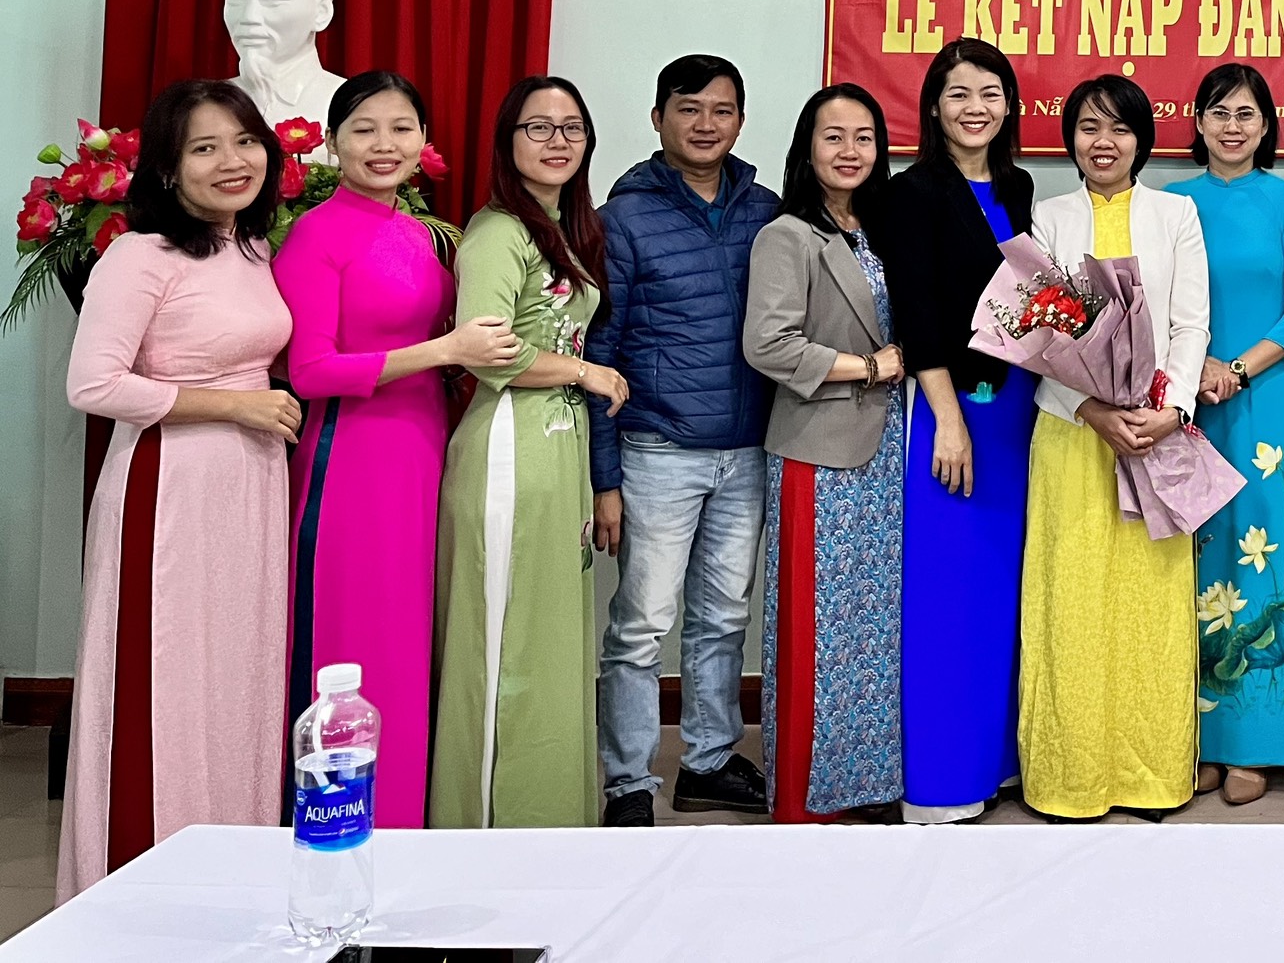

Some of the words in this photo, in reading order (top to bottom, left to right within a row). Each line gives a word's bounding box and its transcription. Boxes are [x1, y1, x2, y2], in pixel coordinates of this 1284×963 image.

[1032, 96, 1064, 116] Nẵ
[1152, 102, 1177, 119] 29
[304, 798, 365, 823] AQUAFINA
